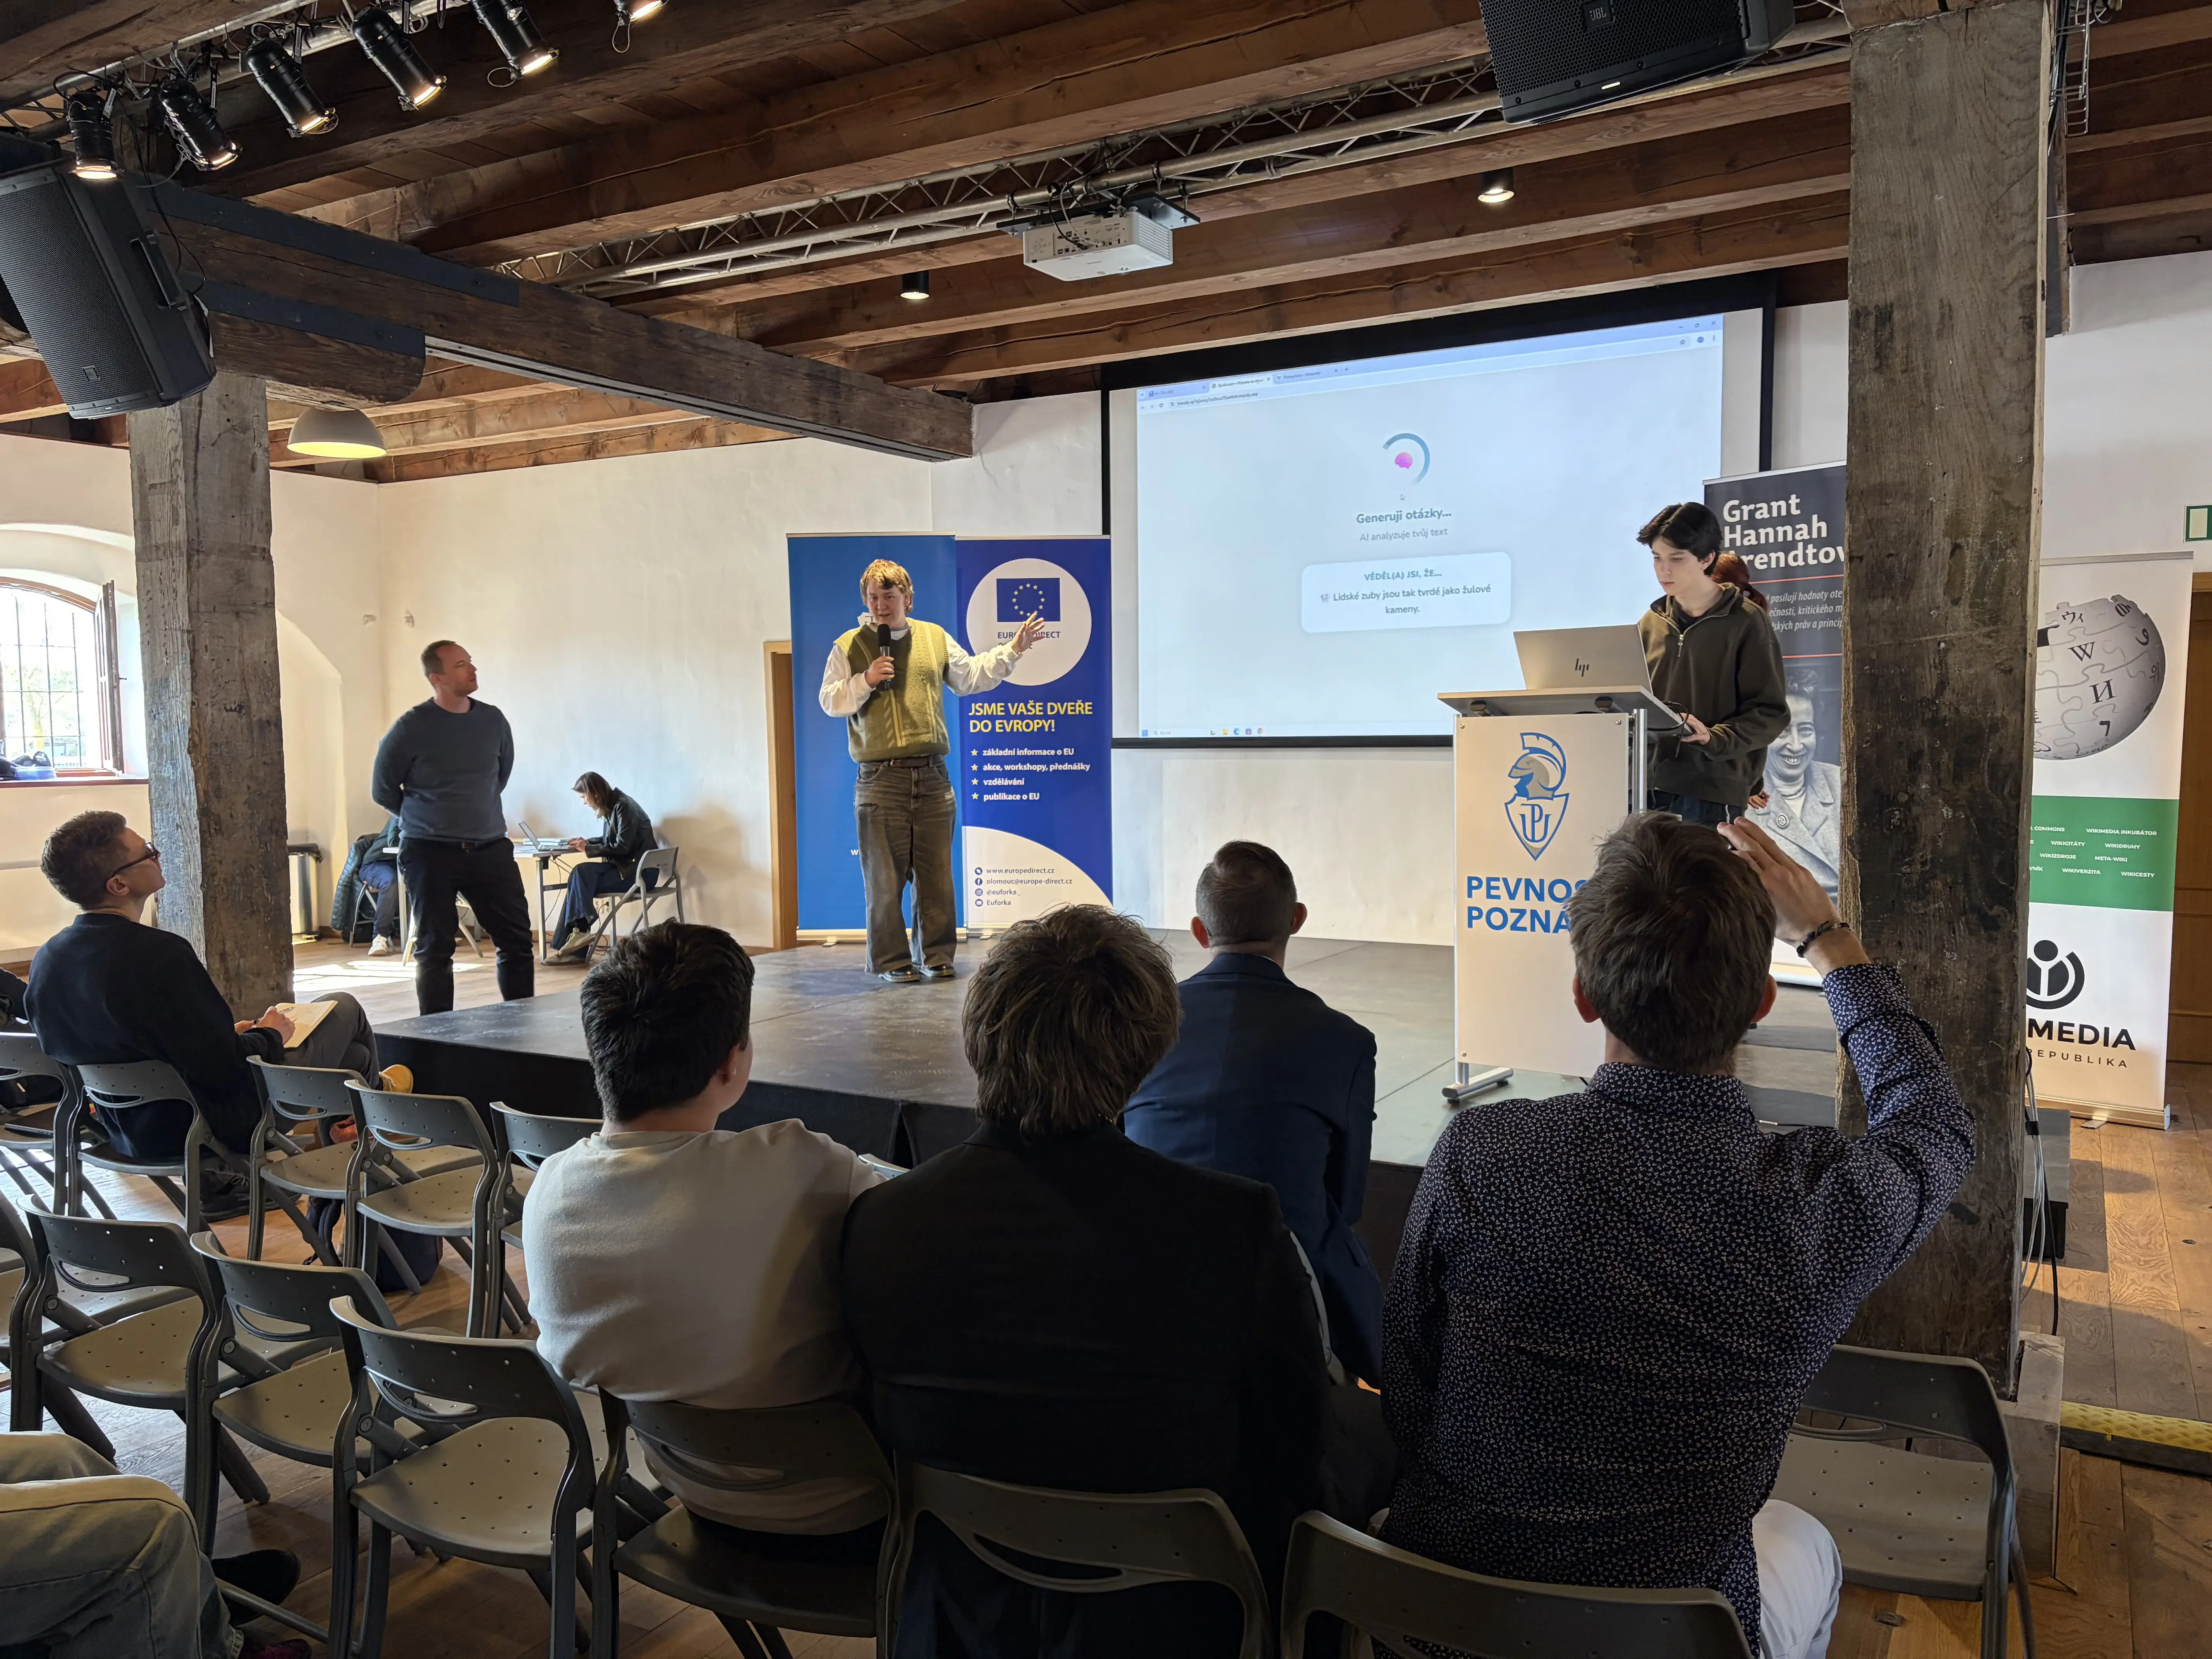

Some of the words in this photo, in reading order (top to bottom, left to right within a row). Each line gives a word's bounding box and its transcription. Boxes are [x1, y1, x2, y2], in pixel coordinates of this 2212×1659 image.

[1589, 7, 1606, 21] JBL
[1723, 494, 1801, 522] Grant
[1356, 510, 1402, 523] Generuji
[1406, 508, 1452, 520] otázky...
[1371, 531, 1410, 541] analyzuje
[1413, 529, 1428, 538] tvůj
[1431, 528, 1448, 536] text
[1724, 514, 1827, 548] Hannah
[1729, 542, 1844, 570] rendtov
[1364, 571, 1404, 580] VĚDĚL(A)
[1424, 568, 1442, 577] ŽE...
[1334, 591, 1359, 601] Lidské
[1361, 591, 1381, 600] zuby
[1382, 590, 1400, 600] jsou
[1418, 587, 1440, 596] tvrdé
[1442, 586, 1460, 596] jako
[1462, 584, 1491, 594] žulové
[1770, 592, 1798, 605] posilují
[1798, 591, 1828, 601] hodnoty
[1769, 607, 1796, 617] ečnosti,
[1798, 604, 1833, 615] kritického
[1795, 620, 1811, 631] práv
[2068, 642, 2095, 662] W
[969, 703, 1005, 715] JSME
[1008, 700, 1043, 715] VAŠE
[1047, 700, 1092, 715] DVEŘE
[970, 720, 992, 732] DO
[996, 720, 1055, 732] EVROPY!
[1004, 763, 1048, 771] workshopy,
[1050, 763, 1091, 772] přednášky
[984, 793, 1020, 802] publikace
